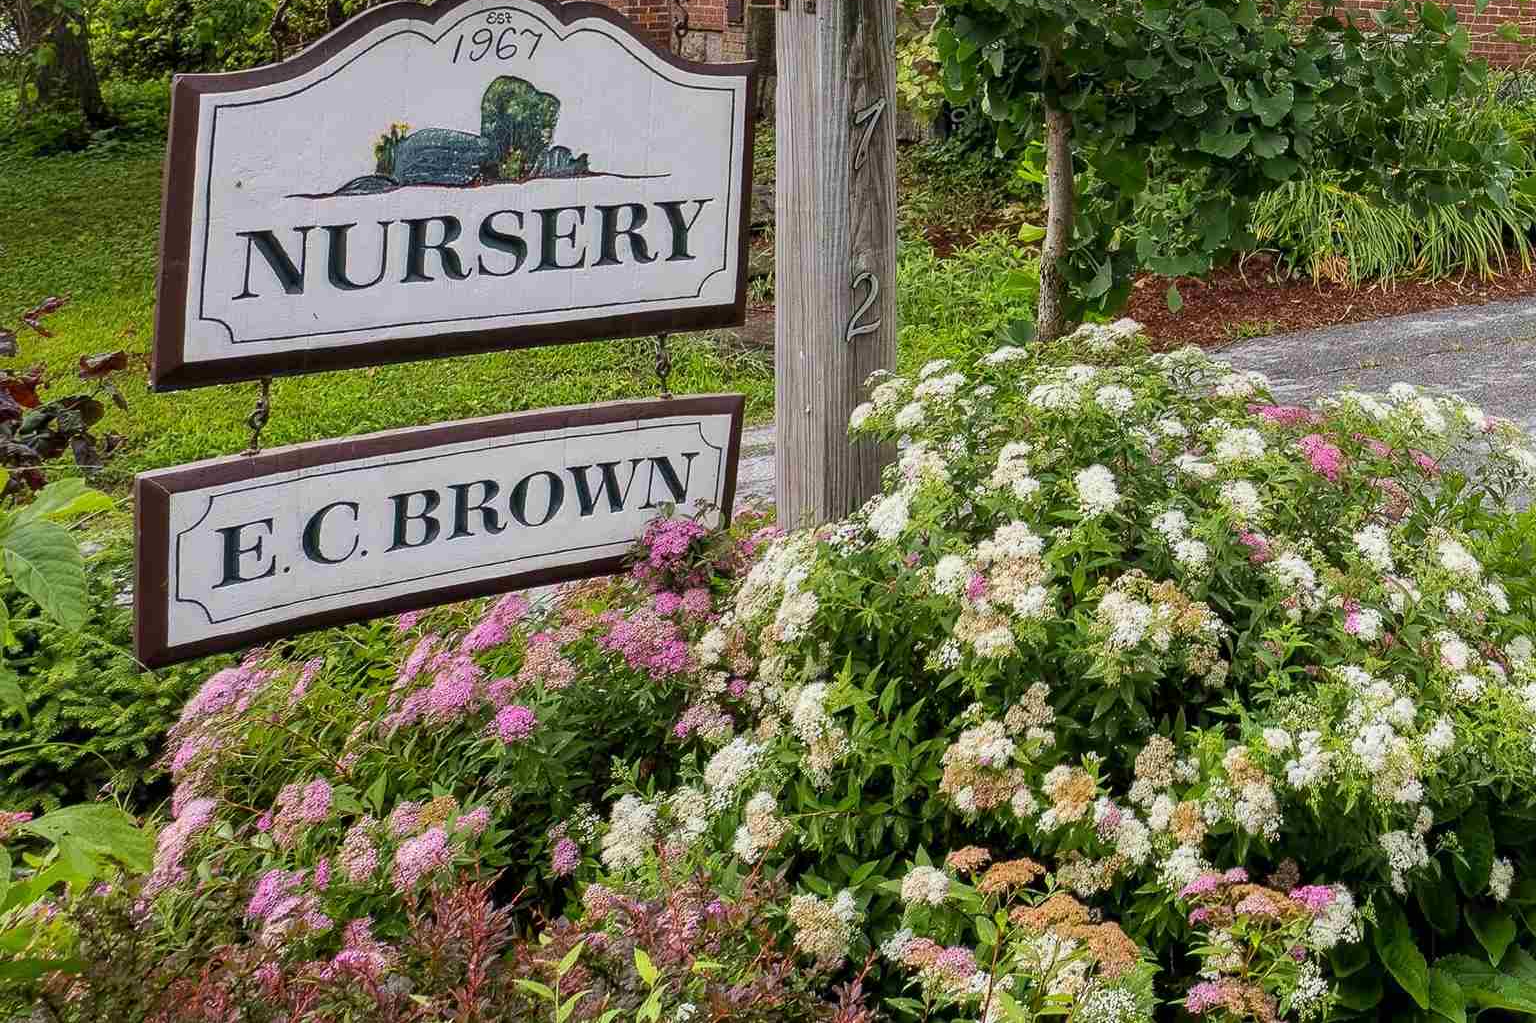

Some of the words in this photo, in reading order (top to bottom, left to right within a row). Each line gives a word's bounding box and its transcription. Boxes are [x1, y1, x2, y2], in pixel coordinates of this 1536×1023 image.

[452, 27, 543, 64] 1967
[231, 198, 715, 302] NURSERY
[384, 451, 700, 553] BROWN
